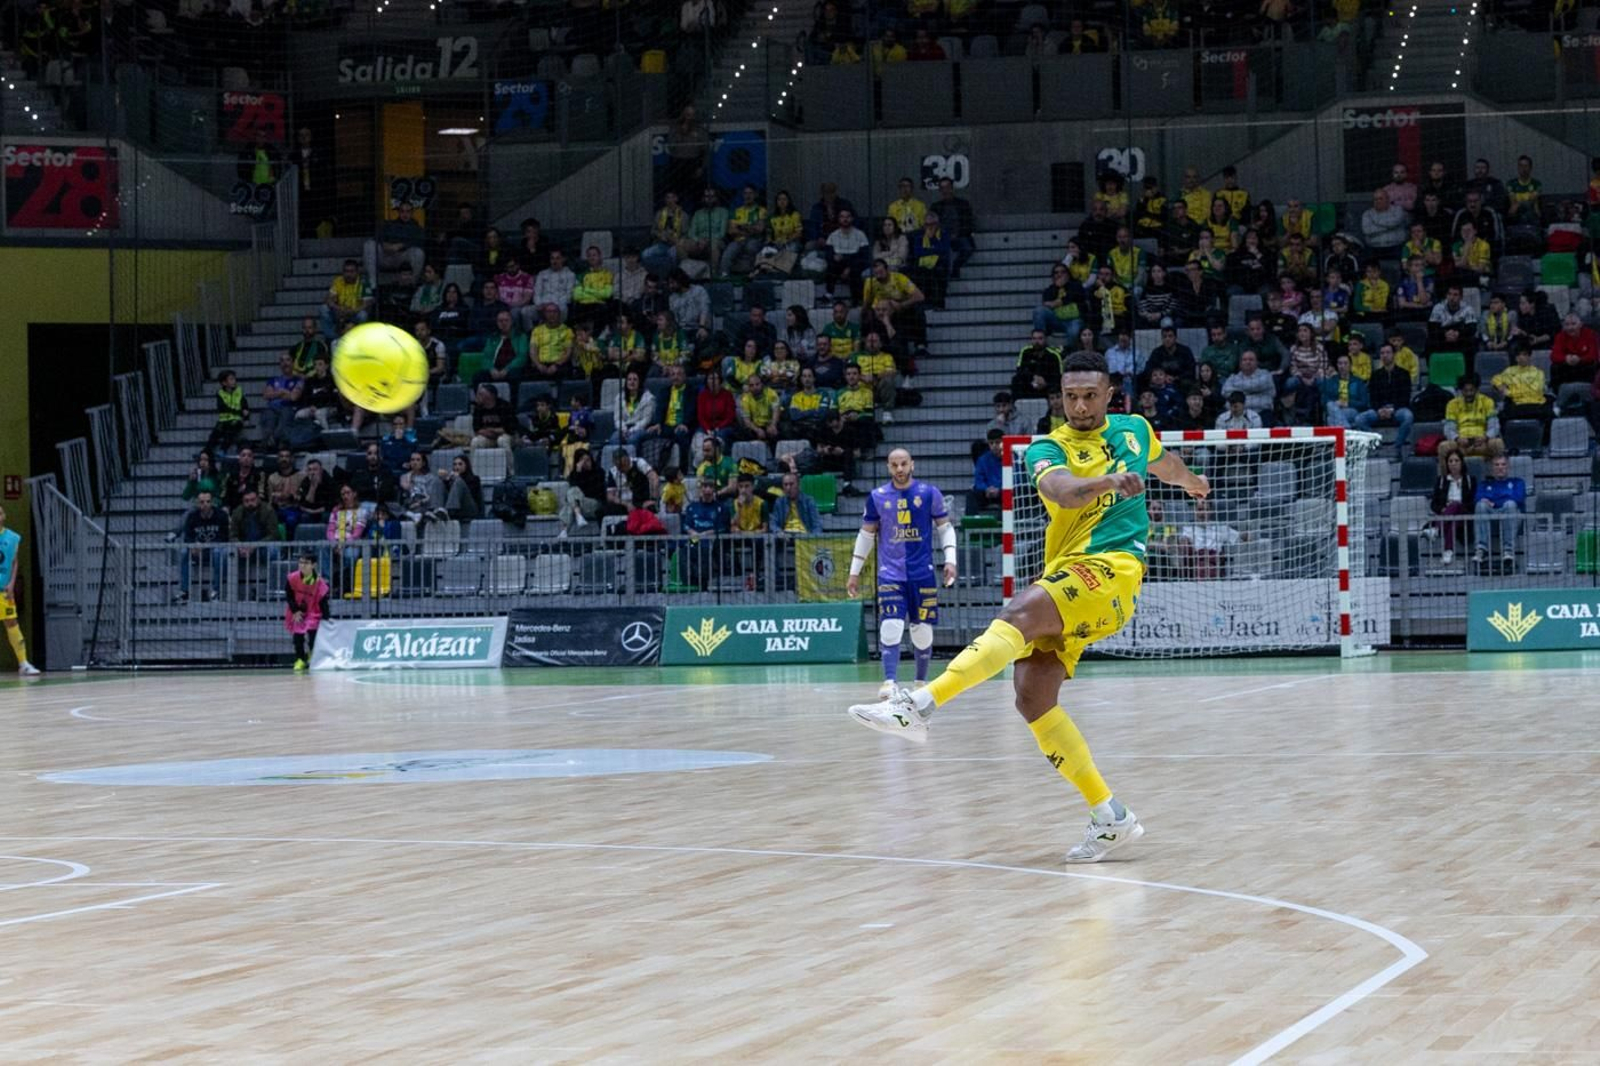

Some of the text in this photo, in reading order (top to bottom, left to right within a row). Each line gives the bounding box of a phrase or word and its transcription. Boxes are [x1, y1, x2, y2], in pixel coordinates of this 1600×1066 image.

[337, 36, 480, 83] Salida 12
[1201, 51, 1247, 63] Sector
[494, 82, 537, 95] Sector
[222, 92, 264, 105] Sector
[1343, 108, 1421, 129] Sector
[2, 146, 77, 167] Sector
[1096, 146, 1146, 183] 30
[922, 154, 970, 190] 30
[6, 147, 119, 228] 28
[230, 201, 266, 215] Sector
[1545, 603, 1594, 619] CAJA
[515, 624, 572, 633] Mercedes-Benz
[735, 617, 843, 634] CAJA RURAL
[1220, 614, 1280, 637] Jaén
[363, 631, 483, 659] El Alcázar
[764, 634, 810, 652] JAÉN
